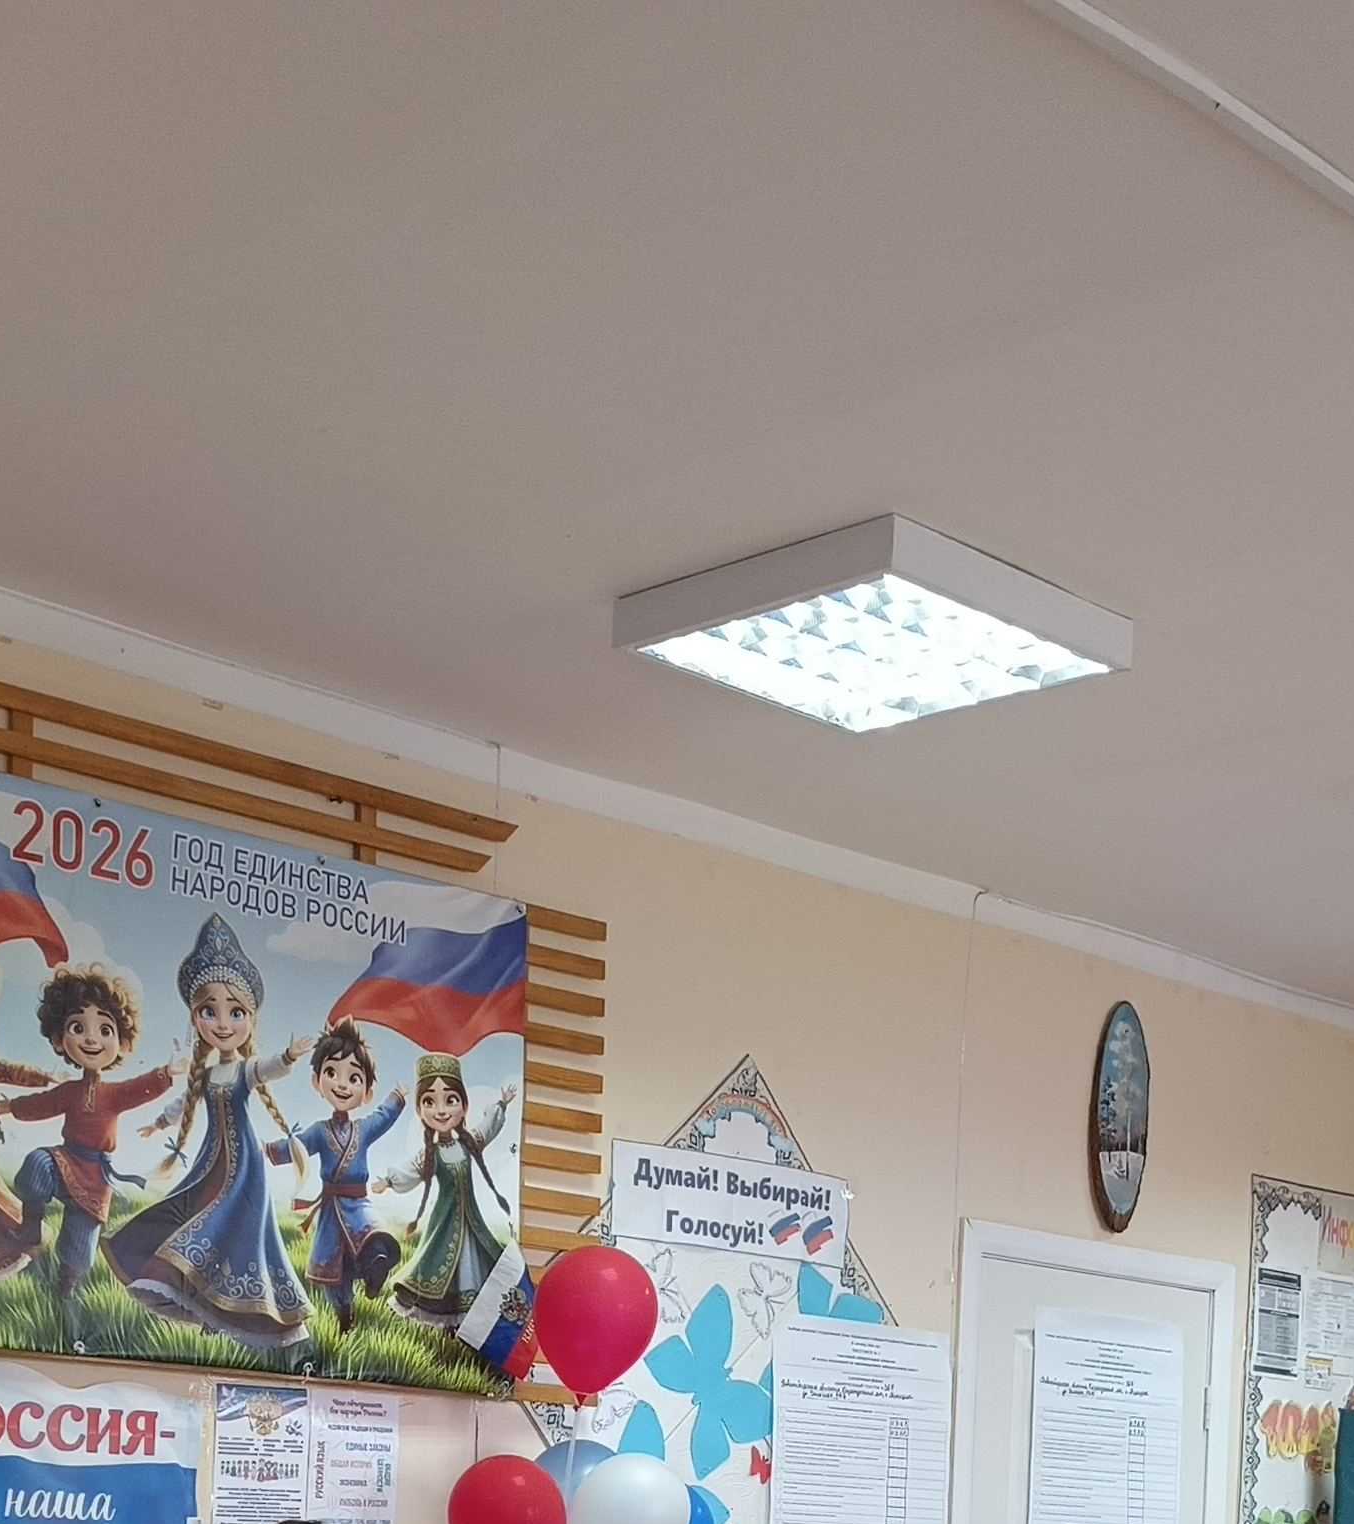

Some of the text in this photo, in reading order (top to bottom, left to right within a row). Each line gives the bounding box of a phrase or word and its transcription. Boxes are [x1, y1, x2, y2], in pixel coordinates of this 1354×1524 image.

[12, 800, 370, 905] 2026 ГОД ЕДИНСТВА
[170, 867, 407, 946] НАРОДОВ РОССИИ
[633, 1157, 832, 1211] Думай! Выбирай!
[666, 1209, 764, 1248] Голосуй!
[4, 1488, 116, 1521] наша
